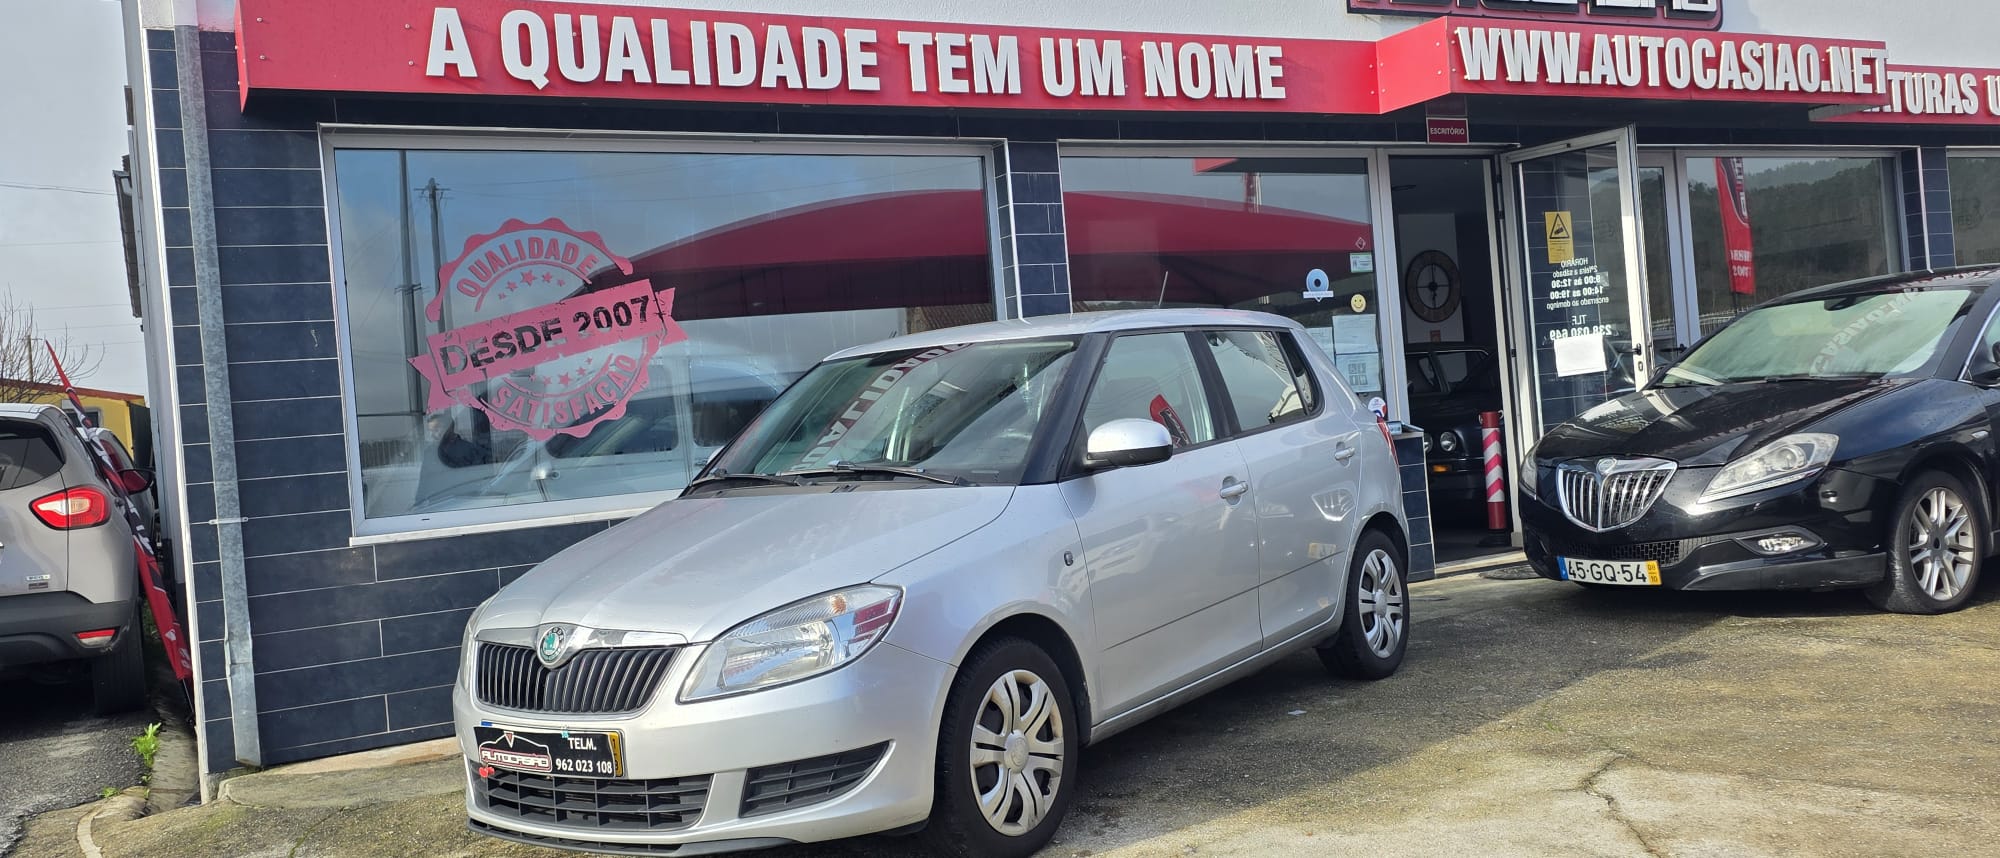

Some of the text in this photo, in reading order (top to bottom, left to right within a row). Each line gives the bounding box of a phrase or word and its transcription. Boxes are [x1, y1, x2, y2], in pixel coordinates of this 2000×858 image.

[425, 8, 1286, 98] A QUALIDADE TEM UM NOME
[1456, 26, 1888, 94] WWW.AUTOCASIAO.NET
[1862, 71, 1979, 115] TURAS
[1430, 126, 1465, 135] ESCRITÓRIO
[456, 236, 600, 297] QUALIDADE
[440, 295, 650, 376] DESDE 2007
[555, 759, 612, 774] 962 023 108
[567, 737, 597, 750] TELM.
